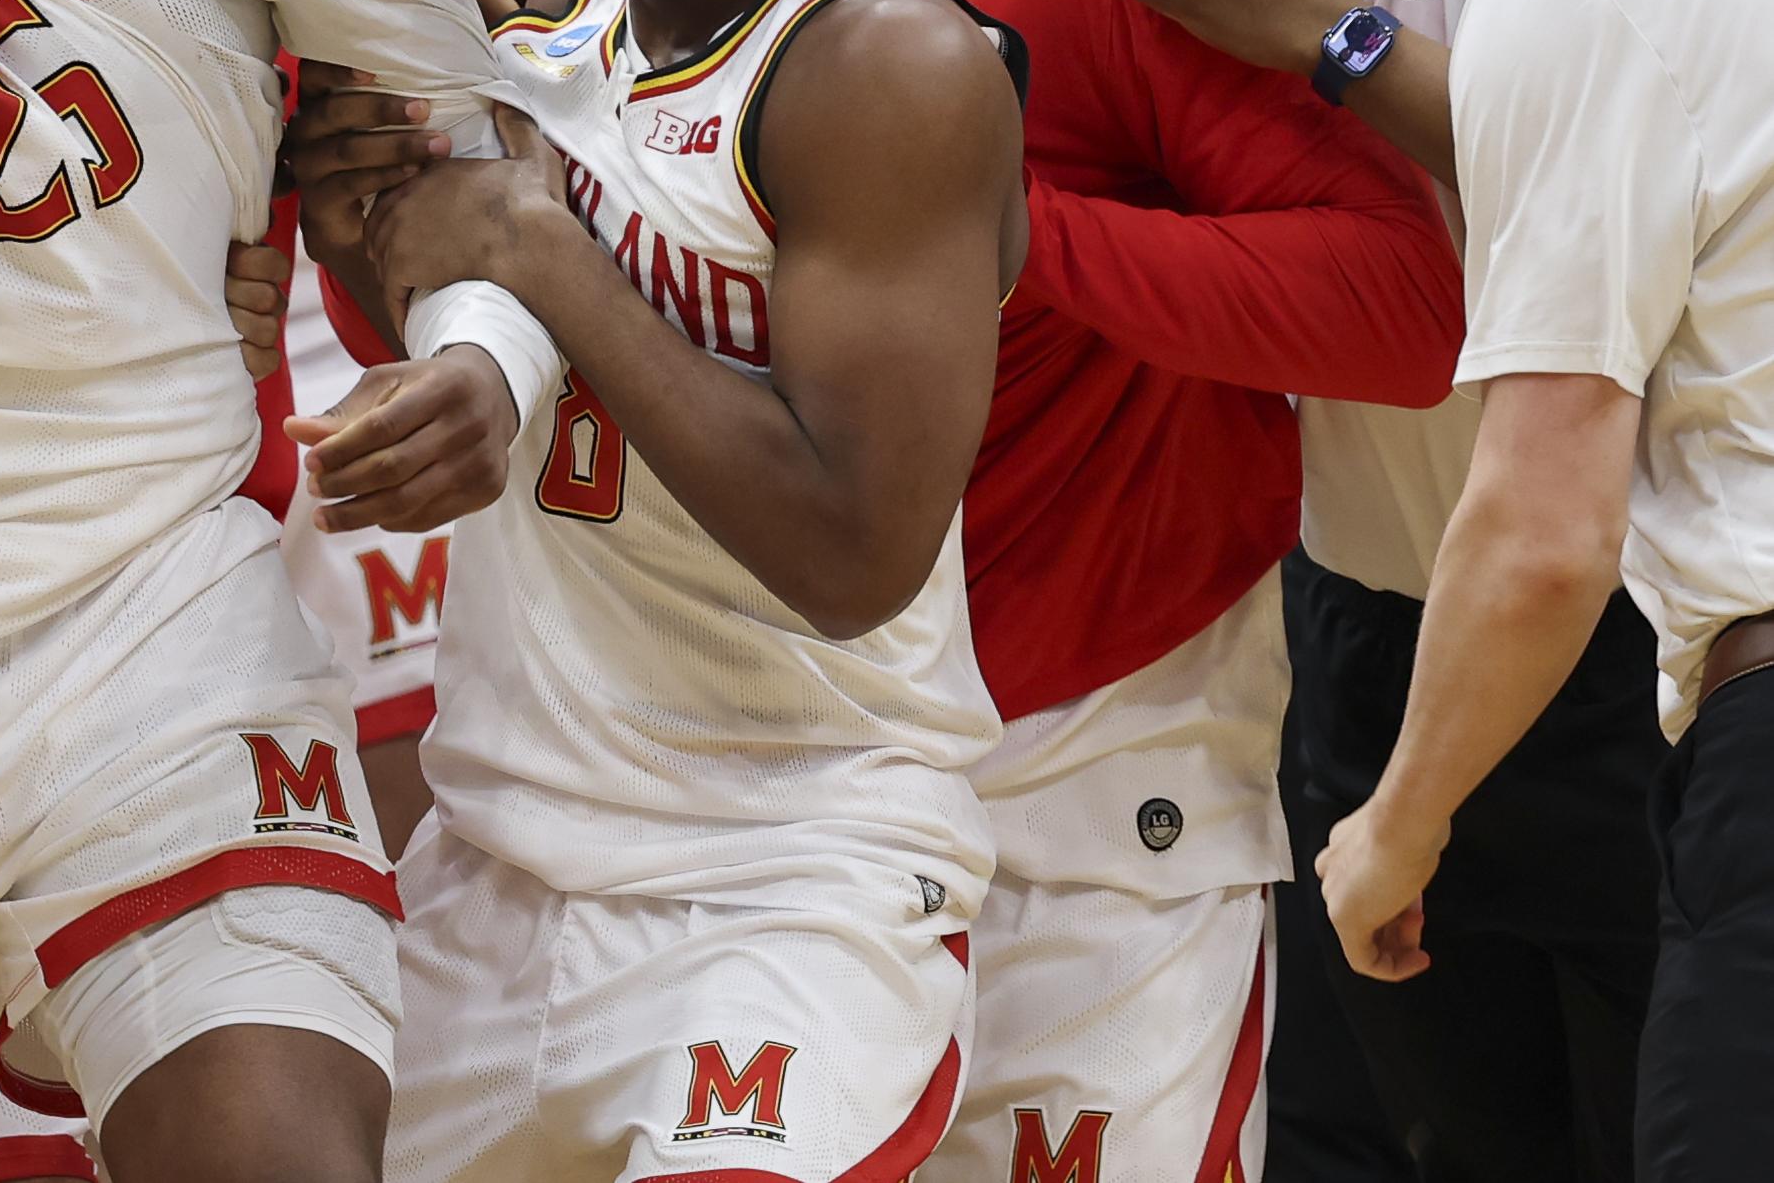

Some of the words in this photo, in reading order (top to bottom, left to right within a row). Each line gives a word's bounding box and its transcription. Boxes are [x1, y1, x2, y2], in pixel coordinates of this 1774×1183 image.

[356, 536, 451, 645] M
[238, 733, 355, 829] M
[1152, 814, 1170, 826] LG
[678, 1040, 798, 1130] M
[1011, 1108, 1113, 1183] M
